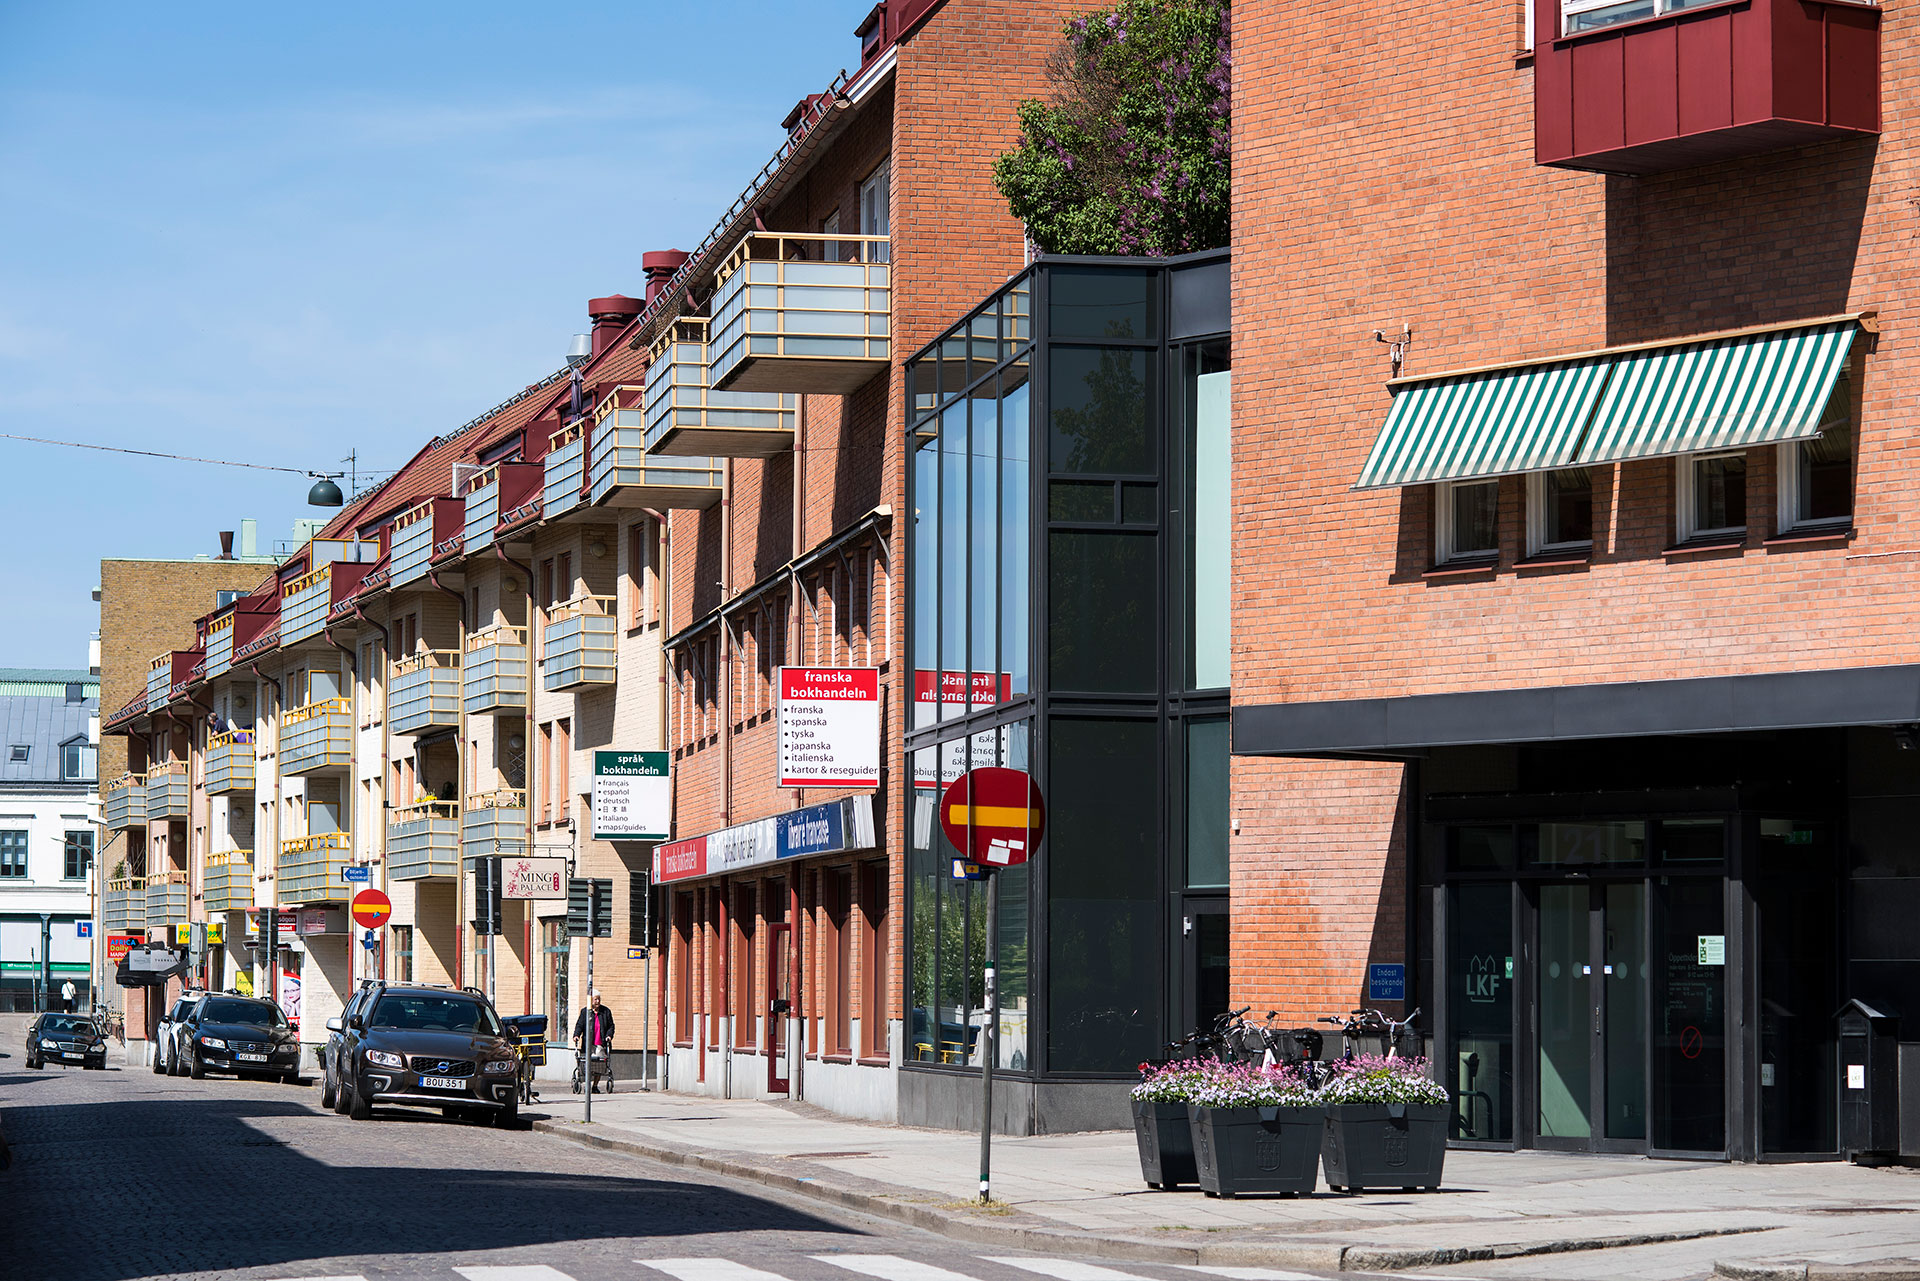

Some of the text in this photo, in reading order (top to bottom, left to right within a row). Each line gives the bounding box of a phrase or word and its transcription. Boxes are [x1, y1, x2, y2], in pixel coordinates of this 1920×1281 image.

[804, 670, 852, 683] franska
[790, 686, 867, 699] bokhandeln
[790, 704, 824, 714] franska
[790, 718, 828, 728] spanska
[791, 729, 815, 740] tyska
[790, 741, 831, 752] japanska
[617, 754, 645, 765] språk
[791, 753, 834, 763] italienska
[602, 765, 660, 776] bokhandeln
[791, 765, 878, 777] kartor & reseguider
[602, 779, 630, 788] français
[602, 788, 630, 797] español
[602, 797, 631, 805] deutsch
[602, 824, 647, 832] maps/guides
[520, 872, 552, 883] MING
[1377, 968, 1397, 977] Endast
[1371, 977, 1404, 986] besökande
[1466, 974, 1500, 996] LKF
[1381, 987, 1393, 996] LKF
[426, 1077, 463, 1088] BOU 351
